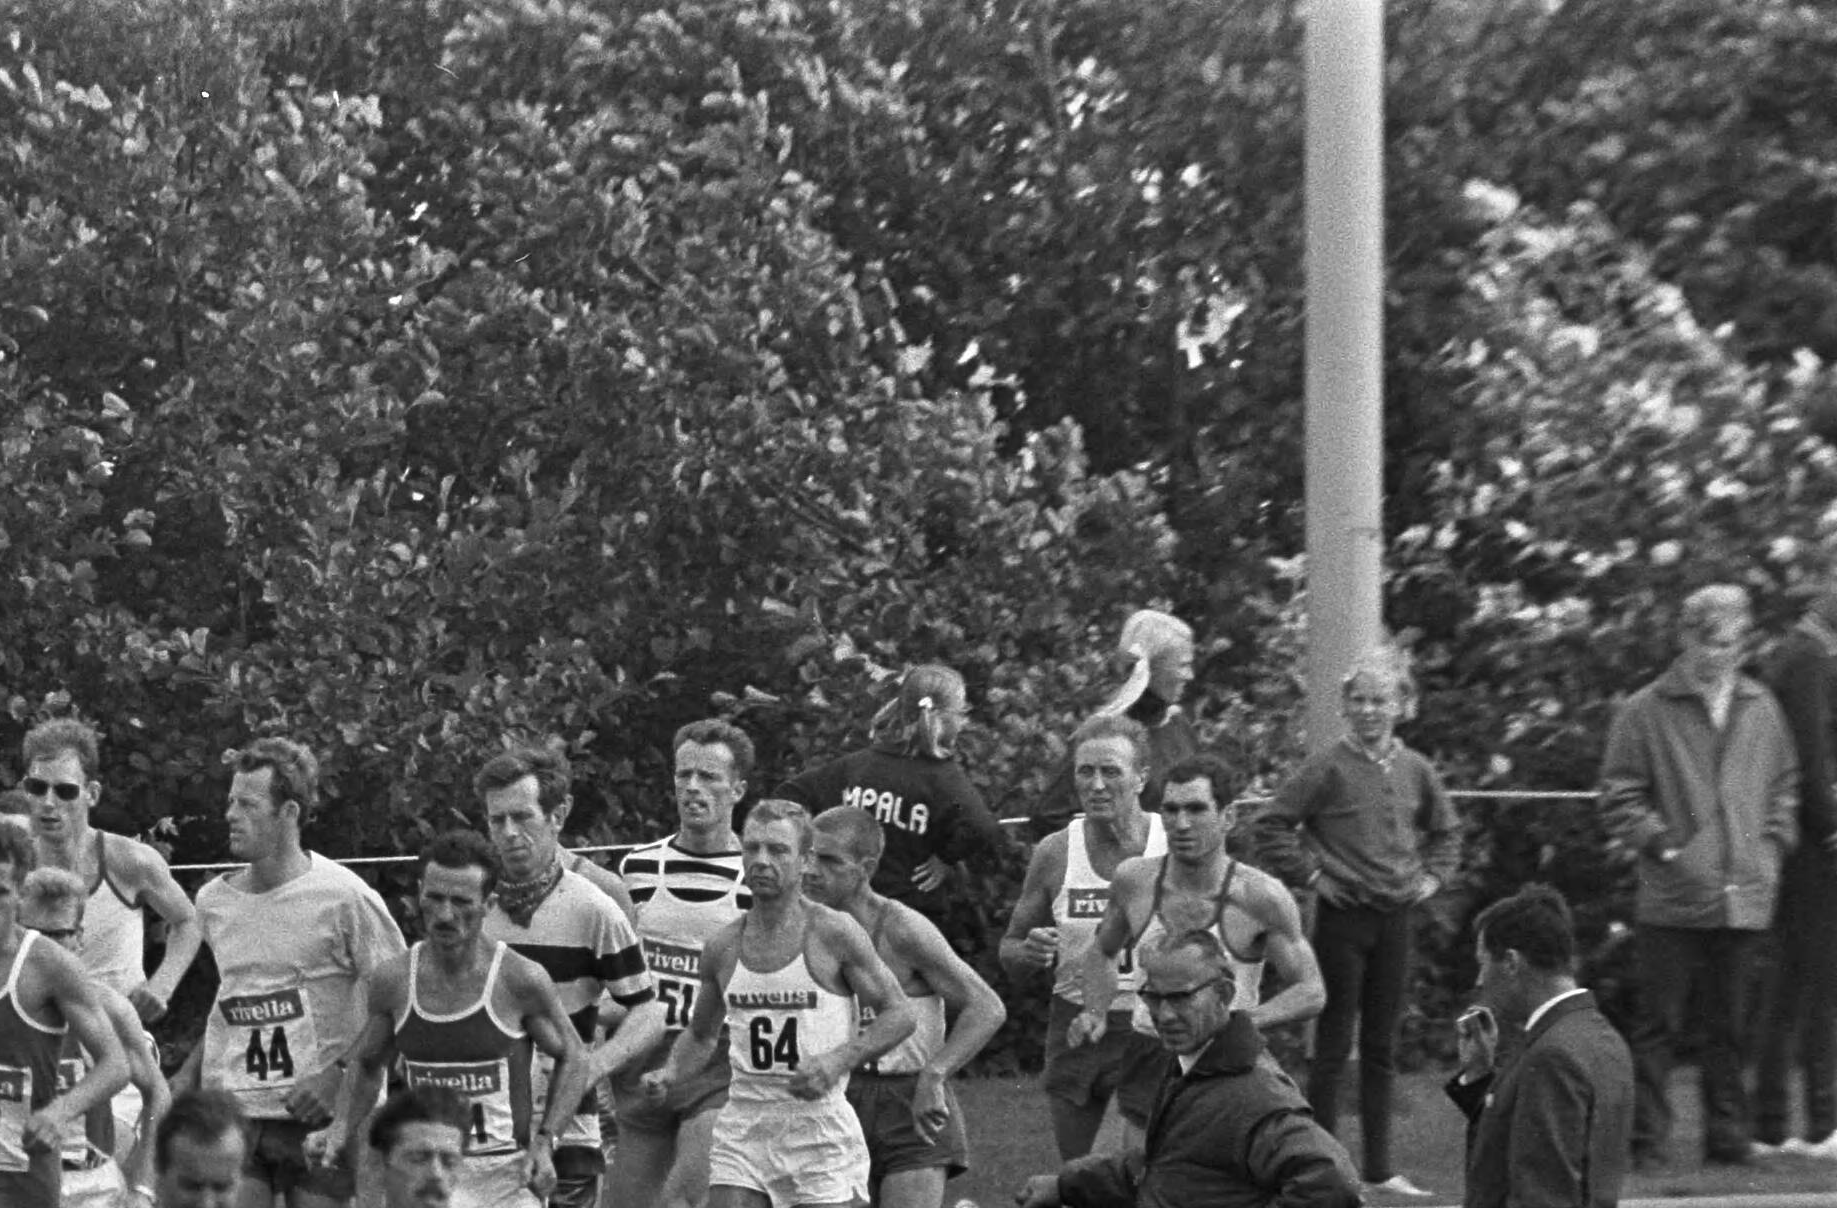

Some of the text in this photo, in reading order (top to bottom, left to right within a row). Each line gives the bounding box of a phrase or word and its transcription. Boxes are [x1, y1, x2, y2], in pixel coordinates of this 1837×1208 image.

[644, 947, 700, 974] rivell
[229, 1000, 295, 1020] rivella
[657, 980, 695, 1028] 51
[246, 1026, 294, 1081] 44
[750, 1016, 799, 1071] 64
